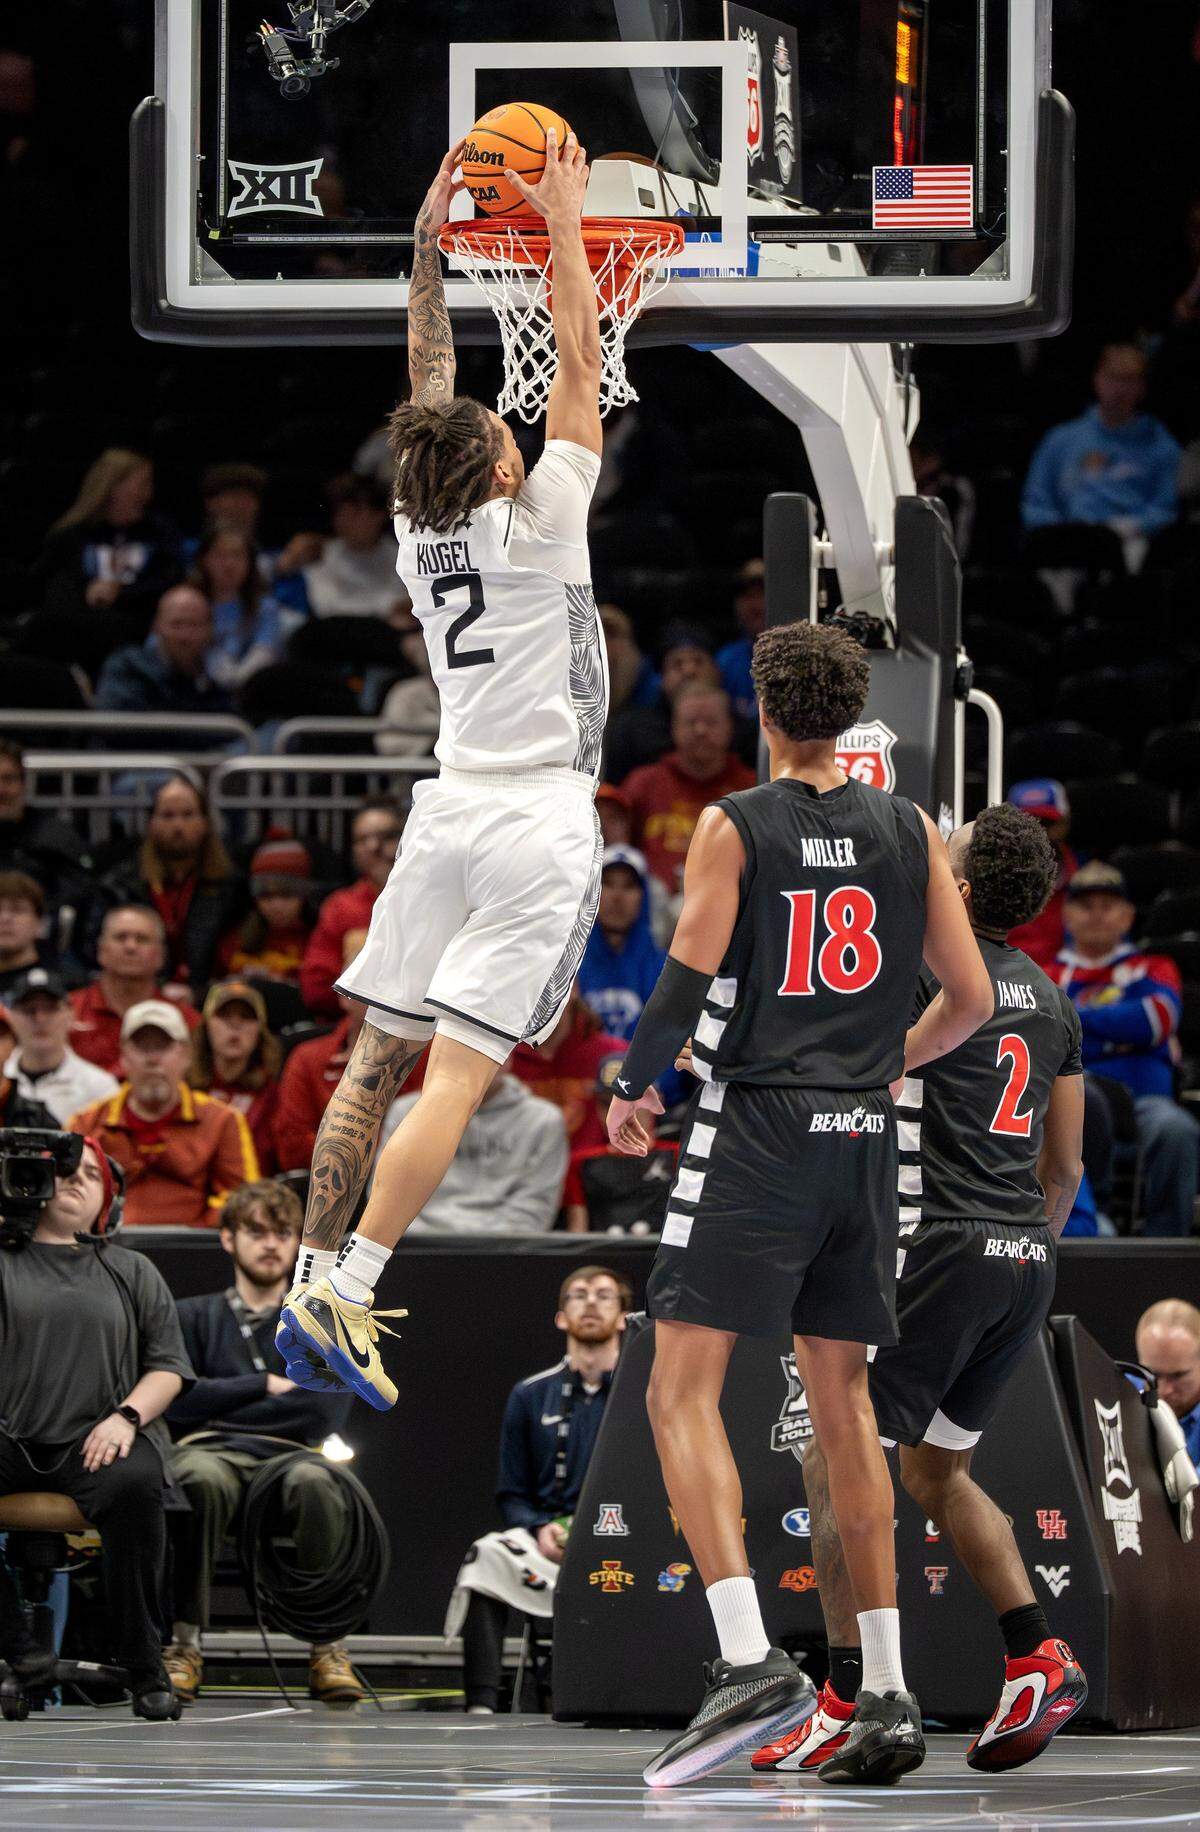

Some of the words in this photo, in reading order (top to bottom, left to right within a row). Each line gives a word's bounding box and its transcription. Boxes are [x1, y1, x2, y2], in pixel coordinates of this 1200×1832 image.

[463, 141, 508, 167] ilson
[416, 540, 481, 575] KUGEL
[430, 572, 496, 670] 2
[837, 734, 881, 748] ILLIPS
[800, 837, 857, 868] MILLER
[777, 885, 883, 996] 18
[997, 980, 1037, 1010] JAMES
[988, 1033, 1034, 1138] 2
[808, 1106, 886, 1134] BEARCATS
[983, 1236, 1047, 1263] BEARCATS
[593, 1504, 628, 1536] A
[589, 1568, 635, 1586] STATE
